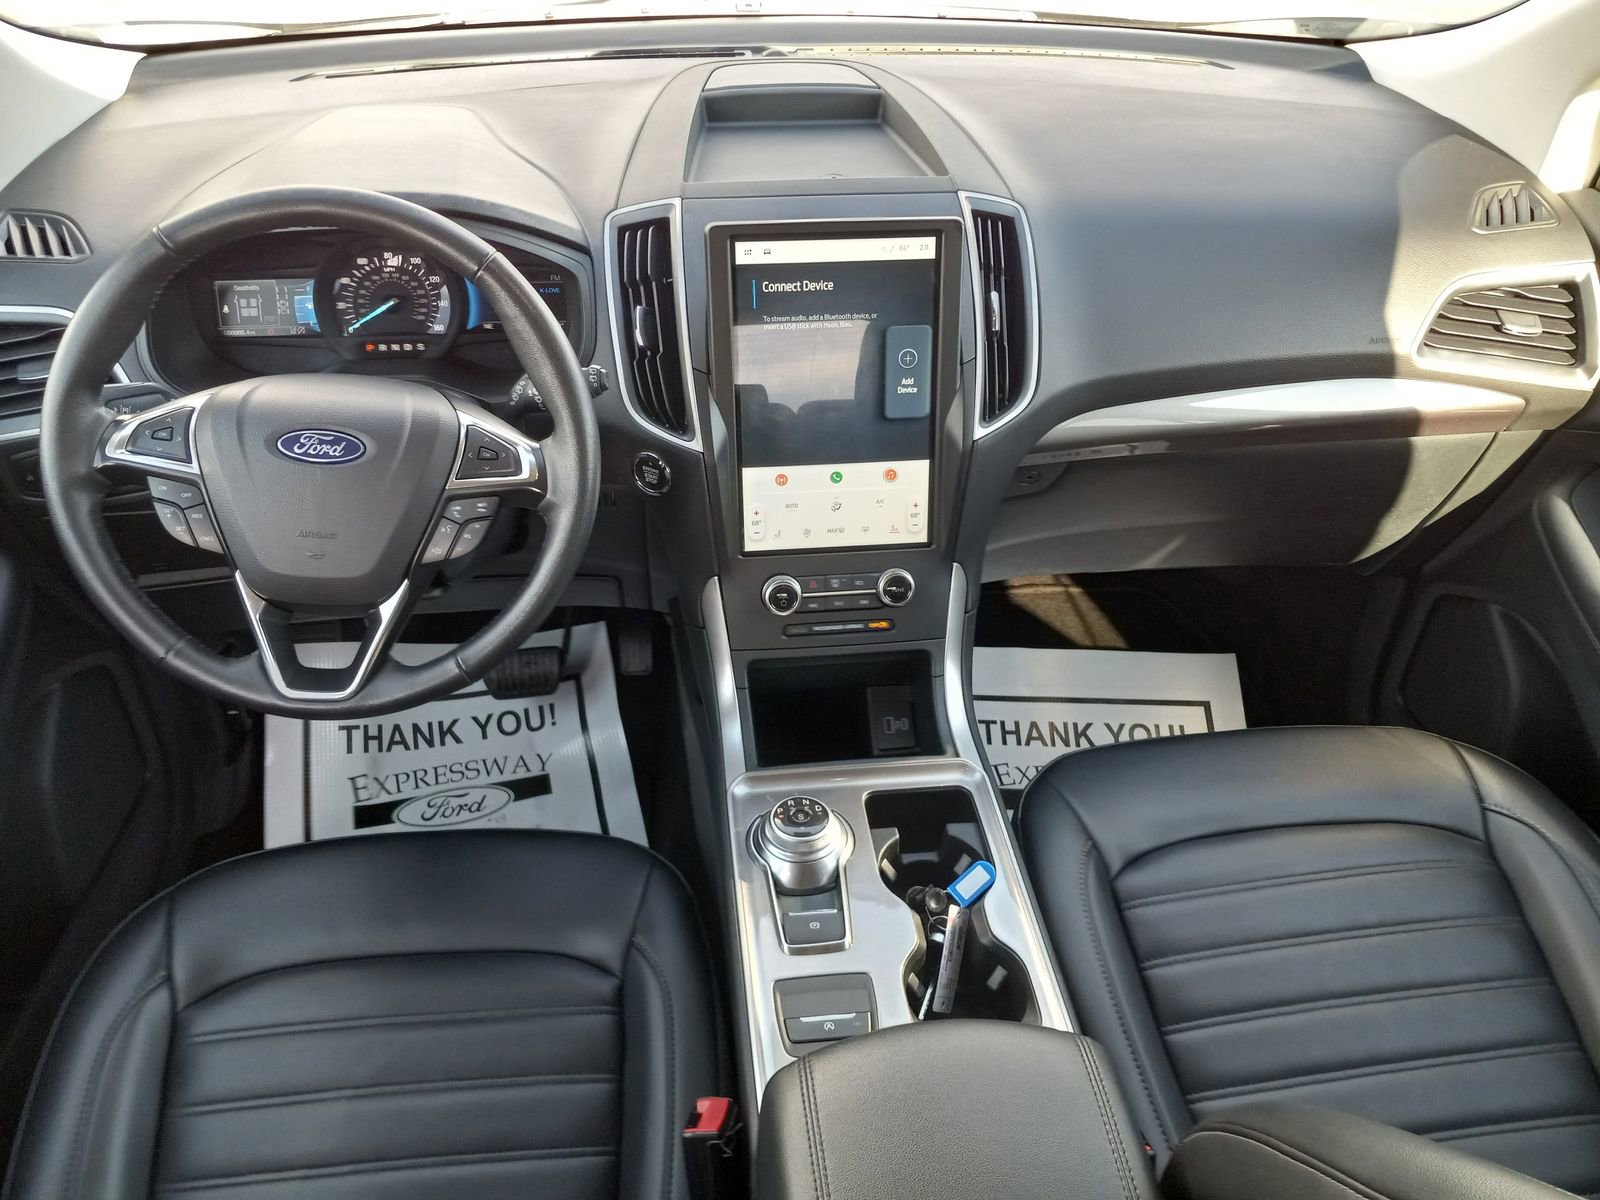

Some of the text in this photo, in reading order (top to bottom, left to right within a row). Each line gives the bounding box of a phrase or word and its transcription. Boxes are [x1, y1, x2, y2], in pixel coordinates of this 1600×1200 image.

[383, 252, 393, 260] 80
[429, 275, 440, 283] 120
[762, 280, 834, 292] Connect Device
[791, 314, 807, 322] audio,
[852, 312, 871, 320] device,
[901, 377, 914, 385] Add
[897, 386, 918, 394] Device
[293, 433, 346, 456] Ford
[338, 703, 557, 754] THANK YOU!
[978, 719, 1096, 748] THANK
[420, 792, 487, 821] Ford
[815, 804, 822, 812] D
